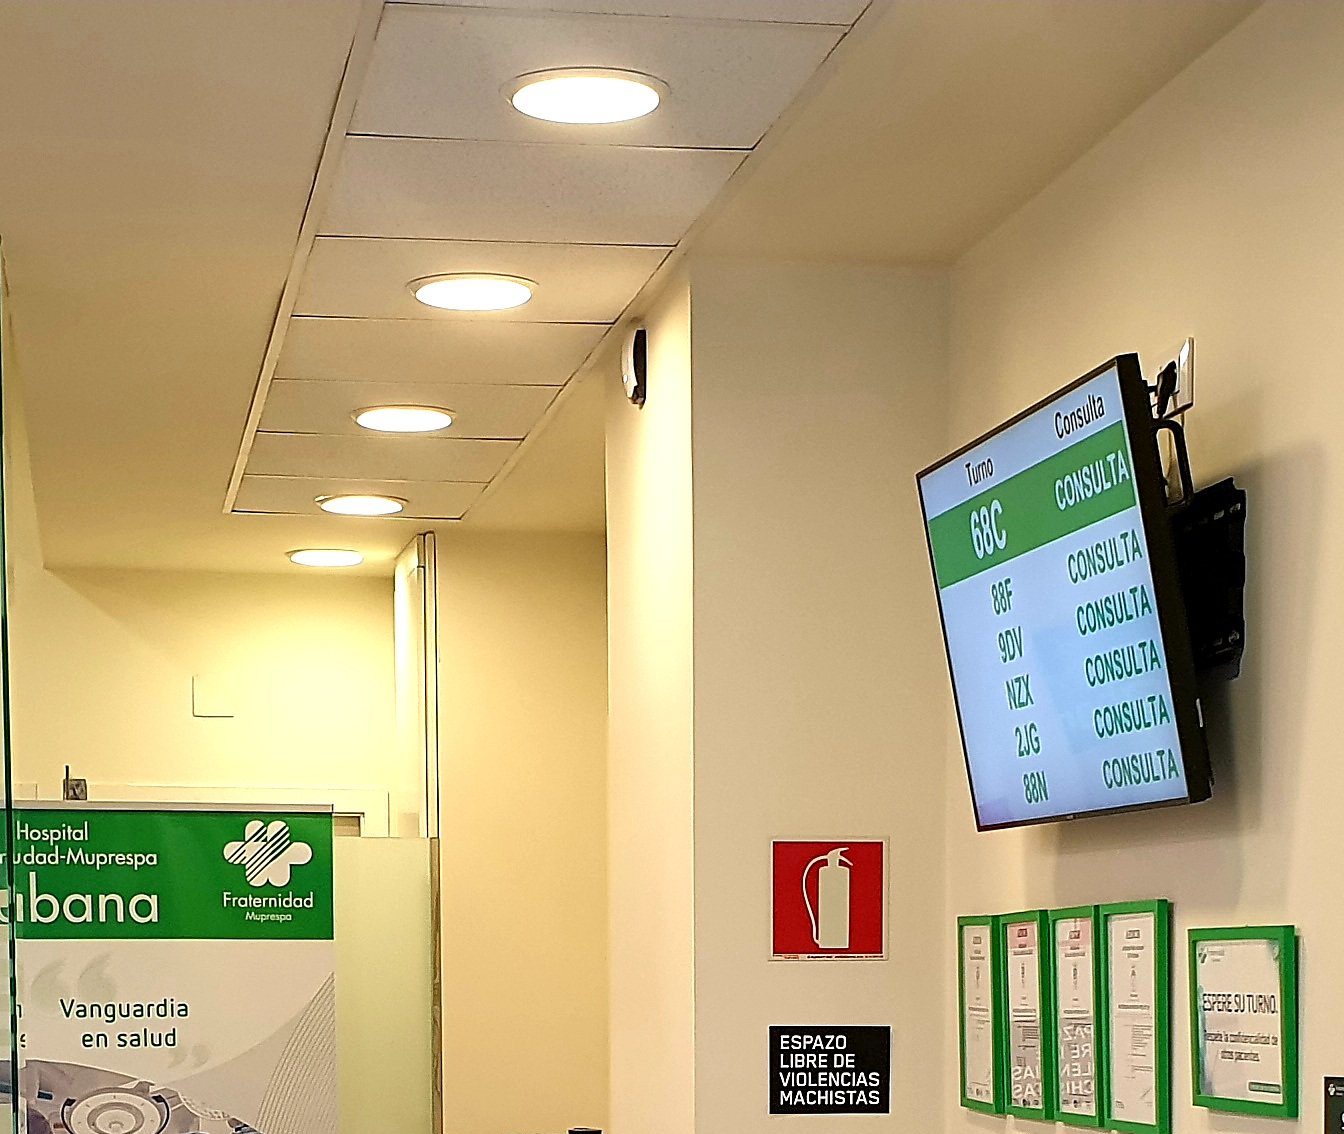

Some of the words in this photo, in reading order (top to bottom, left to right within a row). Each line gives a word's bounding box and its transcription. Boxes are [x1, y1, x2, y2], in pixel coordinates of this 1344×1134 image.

[965, 457, 994, 488] Turno
[1055, 393, 1106, 440] Consulta
[970, 497, 1008, 560] 68C
[1055, 448, 1130, 512] CONSULTA
[991, 578, 1014, 616] 88F
[1067, 529, 1143, 584] CONSULTA
[998, 630, 1024, 664] 9DV
[1077, 584, 1153, 637] CONSULTA
[1005, 674, 1035, 711] NZX
[1085, 640, 1162, 687] CONSULTA
[1015, 722, 1041, 758] 2JG
[1093, 694, 1171, 740] CONSULTA
[1023, 771, 1048, 805] 88N
[1103, 749, 1180, 790] CONSULTA
[16, 820, 89, 843] Hospital
[223, 891, 313, 908] Fraternidad
[245, 911, 292, 923] Muprespa
[60, 998, 188, 1022] Vanguardia
[1202, 993, 1233, 1012] ESPERE
[1234, 994, 1245, 1013] SU
[1246, 994, 1278, 1014] TURNO.
[82, 1033, 107, 1047] en
[117, 1028, 176, 1047] salud
[781, 1035, 846, 1049] ESPAZO
[781, 1054, 828, 1068] LIBRE
[834, 1054, 855, 1068] DE
[779, 1072, 879, 1087] VIOLENCIAS
[780, 1090, 879, 1105] MACHISTAS
